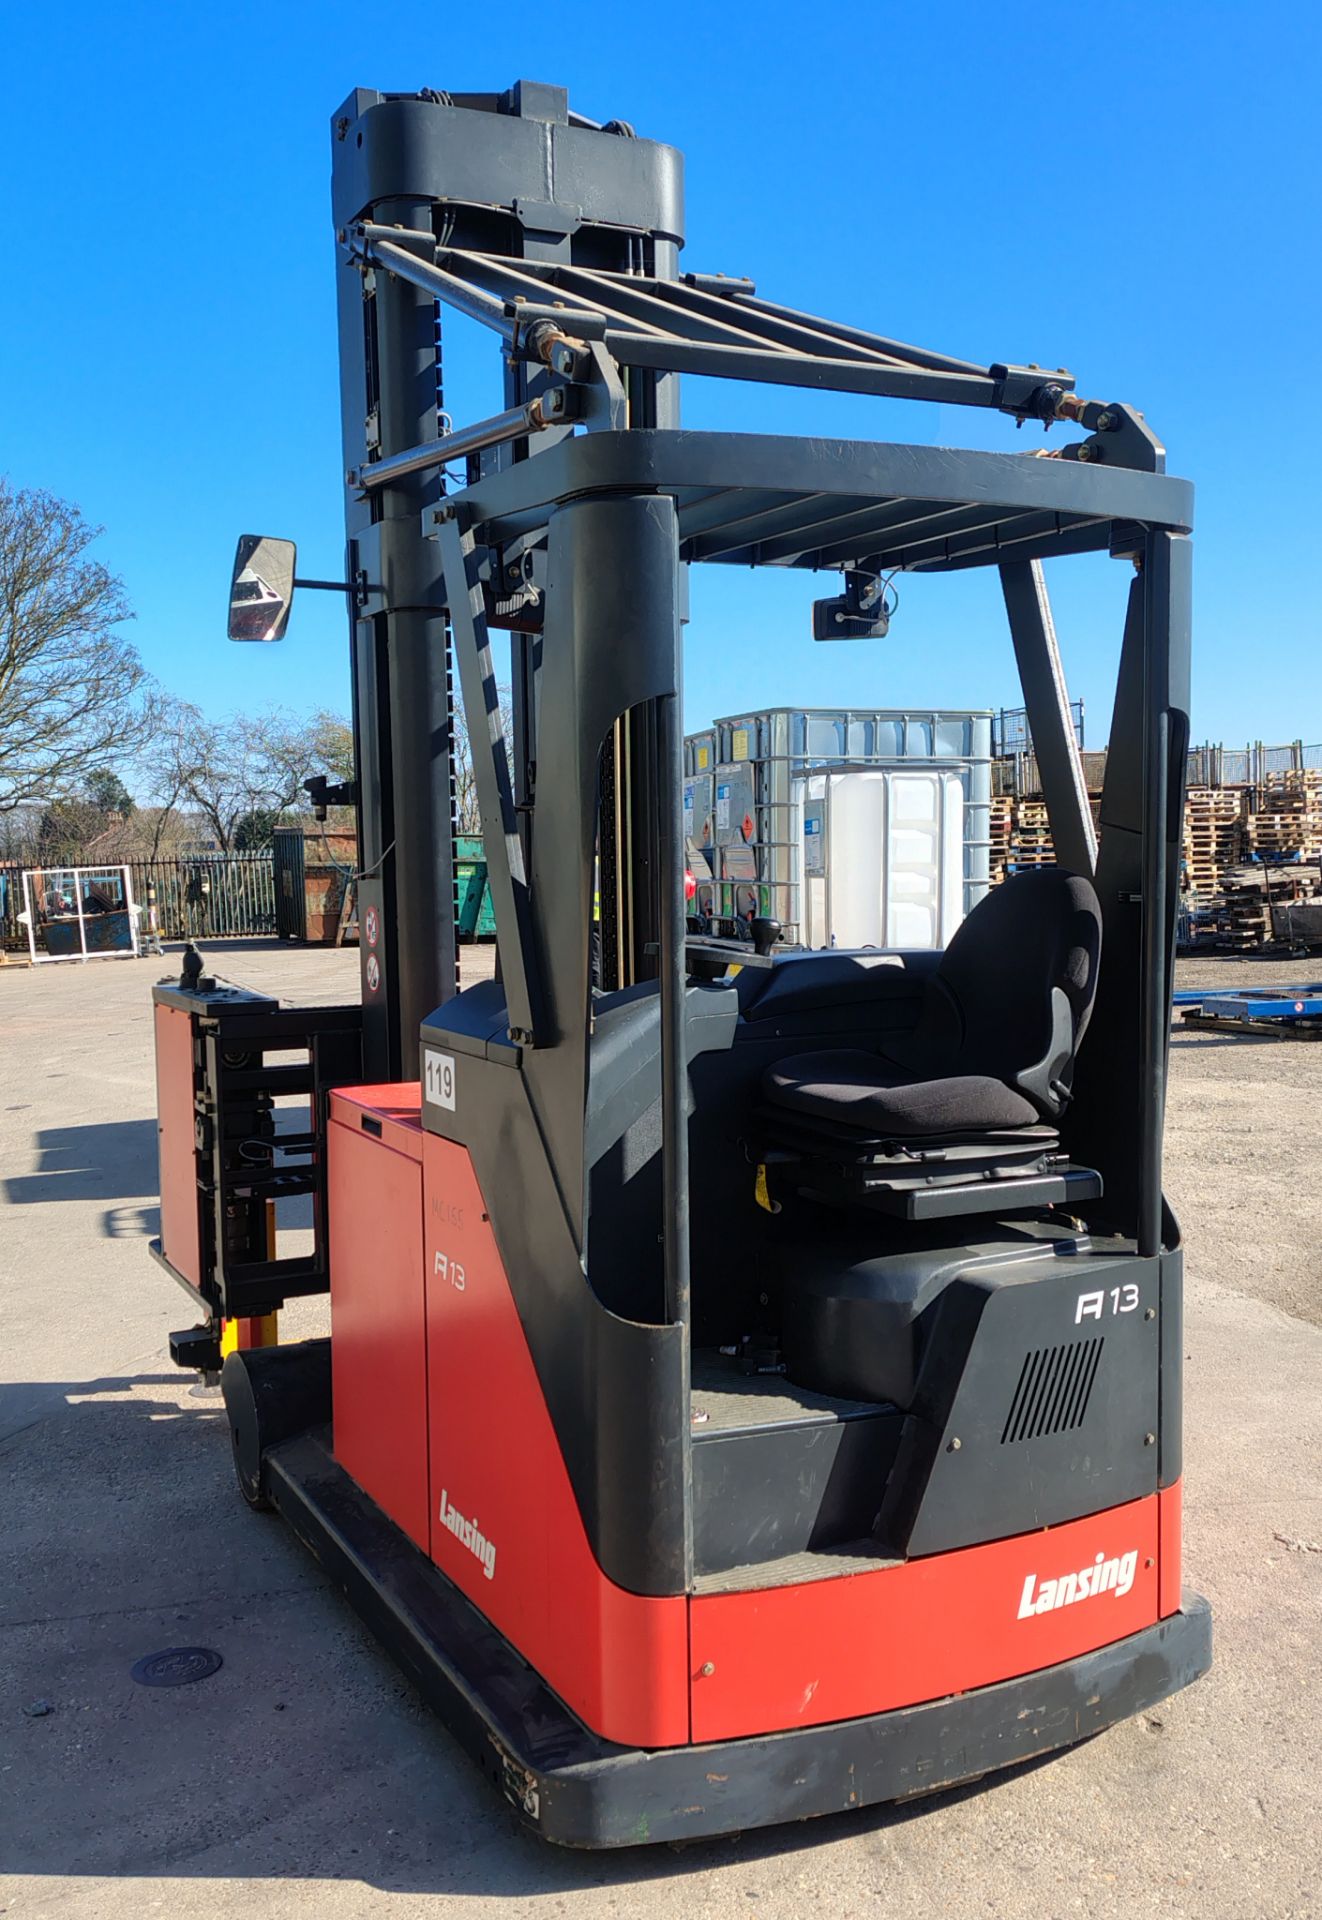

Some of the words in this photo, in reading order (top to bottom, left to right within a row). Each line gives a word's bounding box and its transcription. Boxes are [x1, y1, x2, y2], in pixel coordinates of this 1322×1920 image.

[427, 1060, 452, 1099] 119
[440, 1488, 496, 1580] Lansing
[1017, 1550, 1138, 1620] Lansing
